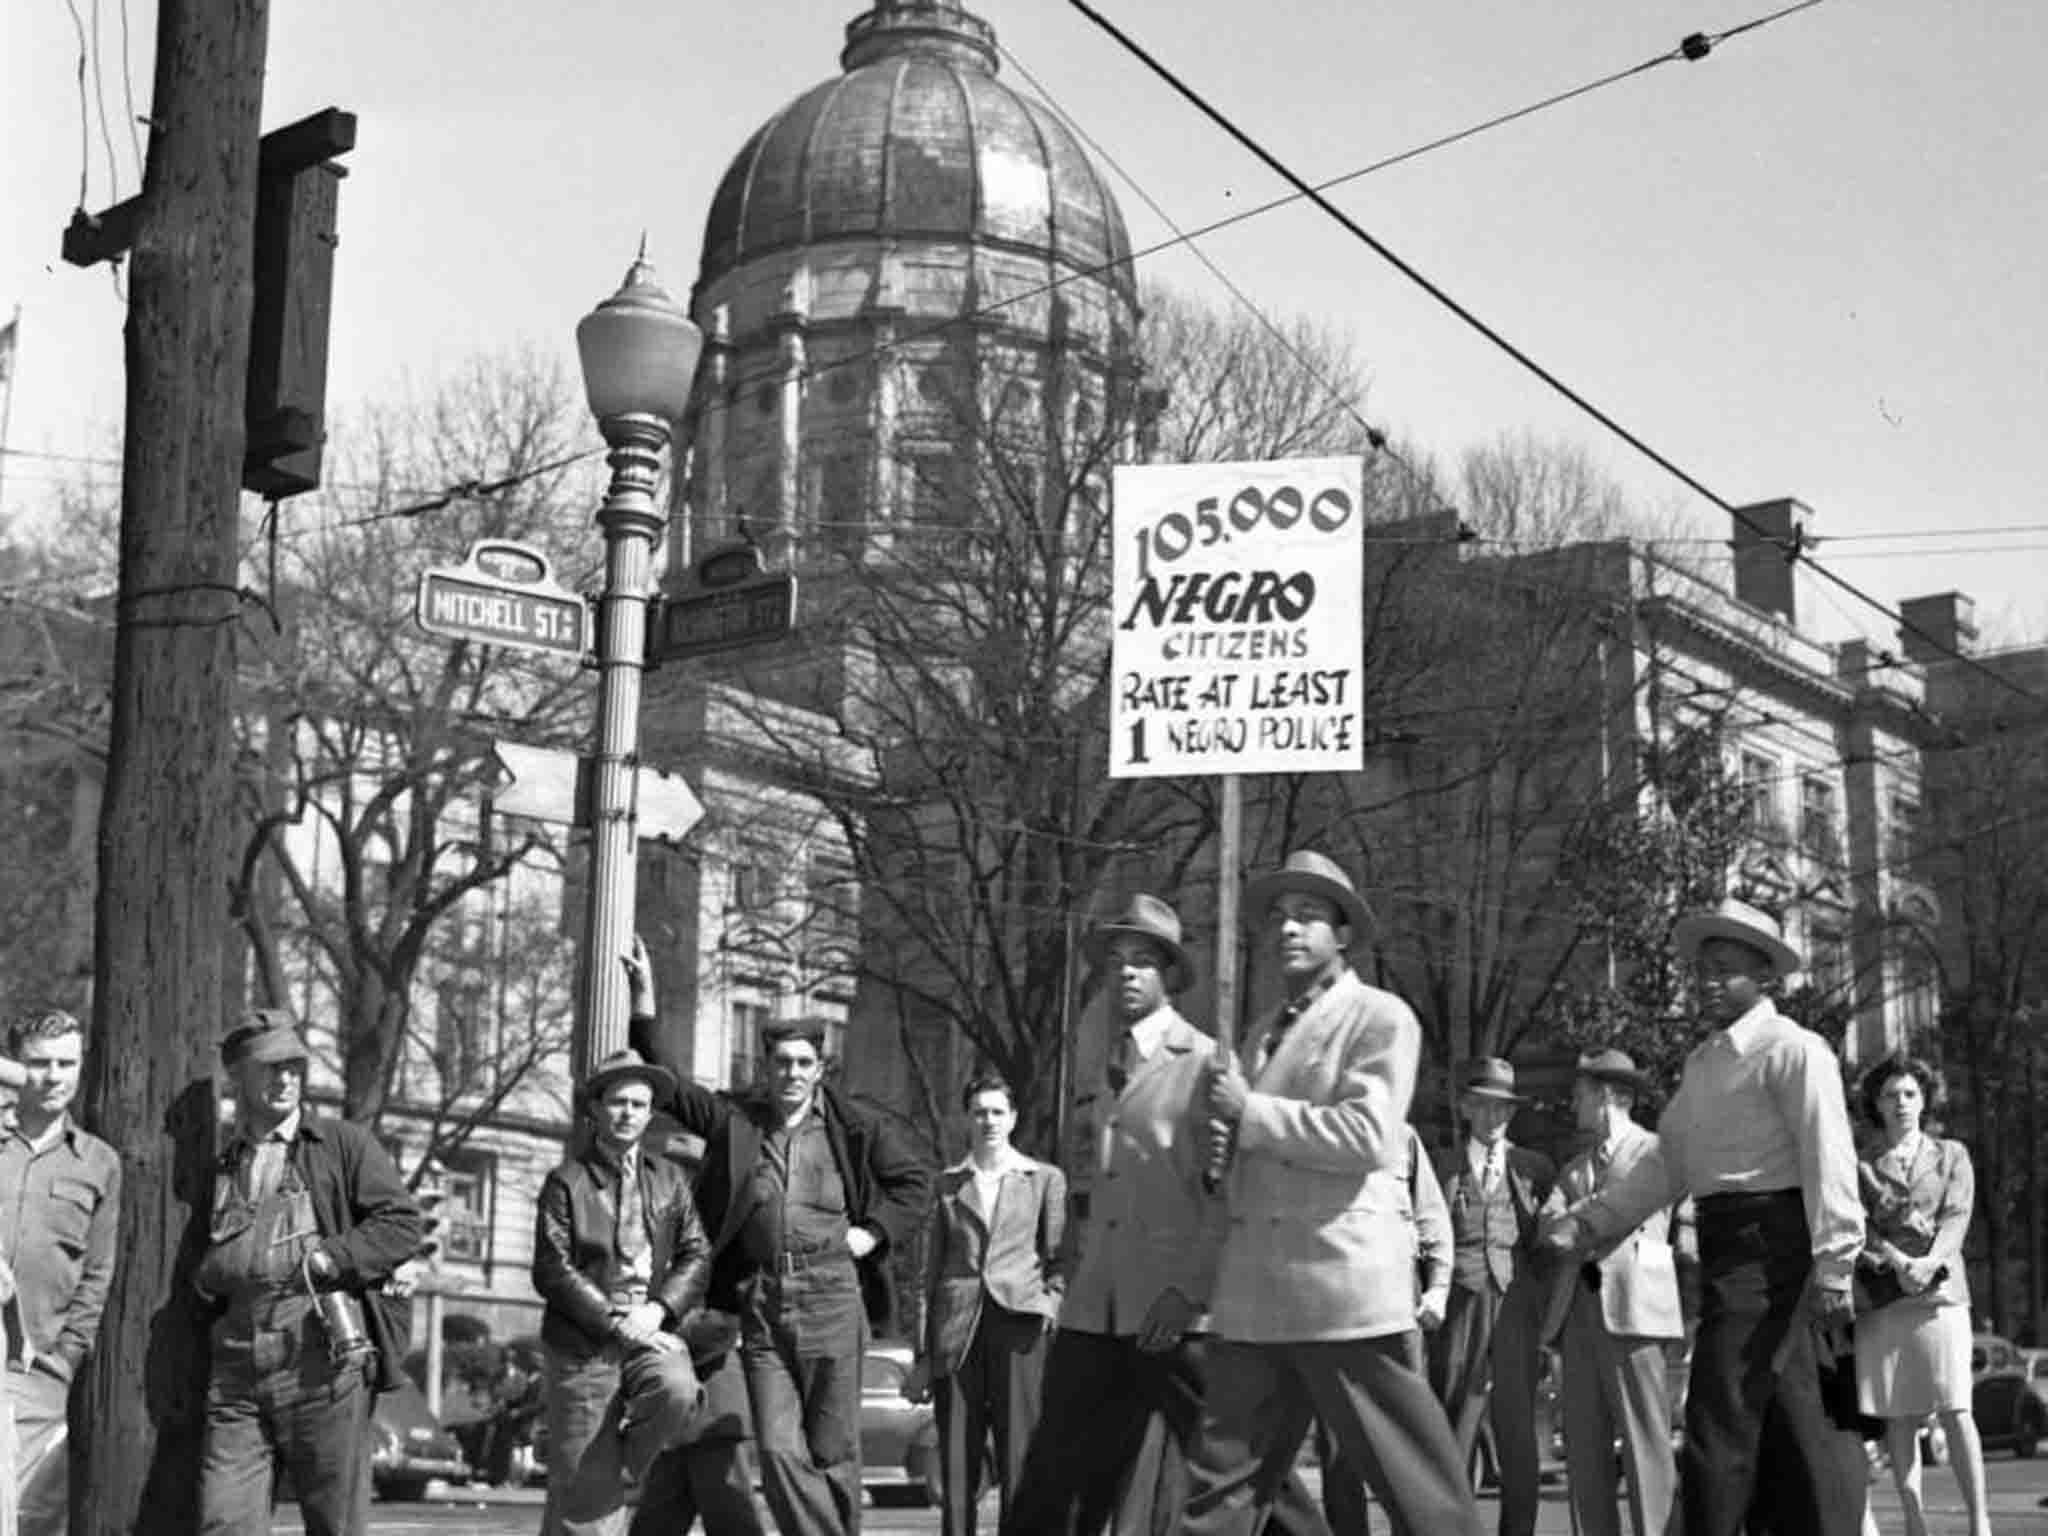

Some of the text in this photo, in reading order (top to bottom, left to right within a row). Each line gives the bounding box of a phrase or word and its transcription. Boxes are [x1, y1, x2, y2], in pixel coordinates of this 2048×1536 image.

[433, 590, 526, 632] MITCHELL
[1119, 571, 1316, 630] NEGRO
[1162, 627, 1309, 660] CITIZENS
[1121, 669, 1350, 711] RATE AT LEAST
[1127, 714, 1354, 764] 1 NEGRO POLICE
